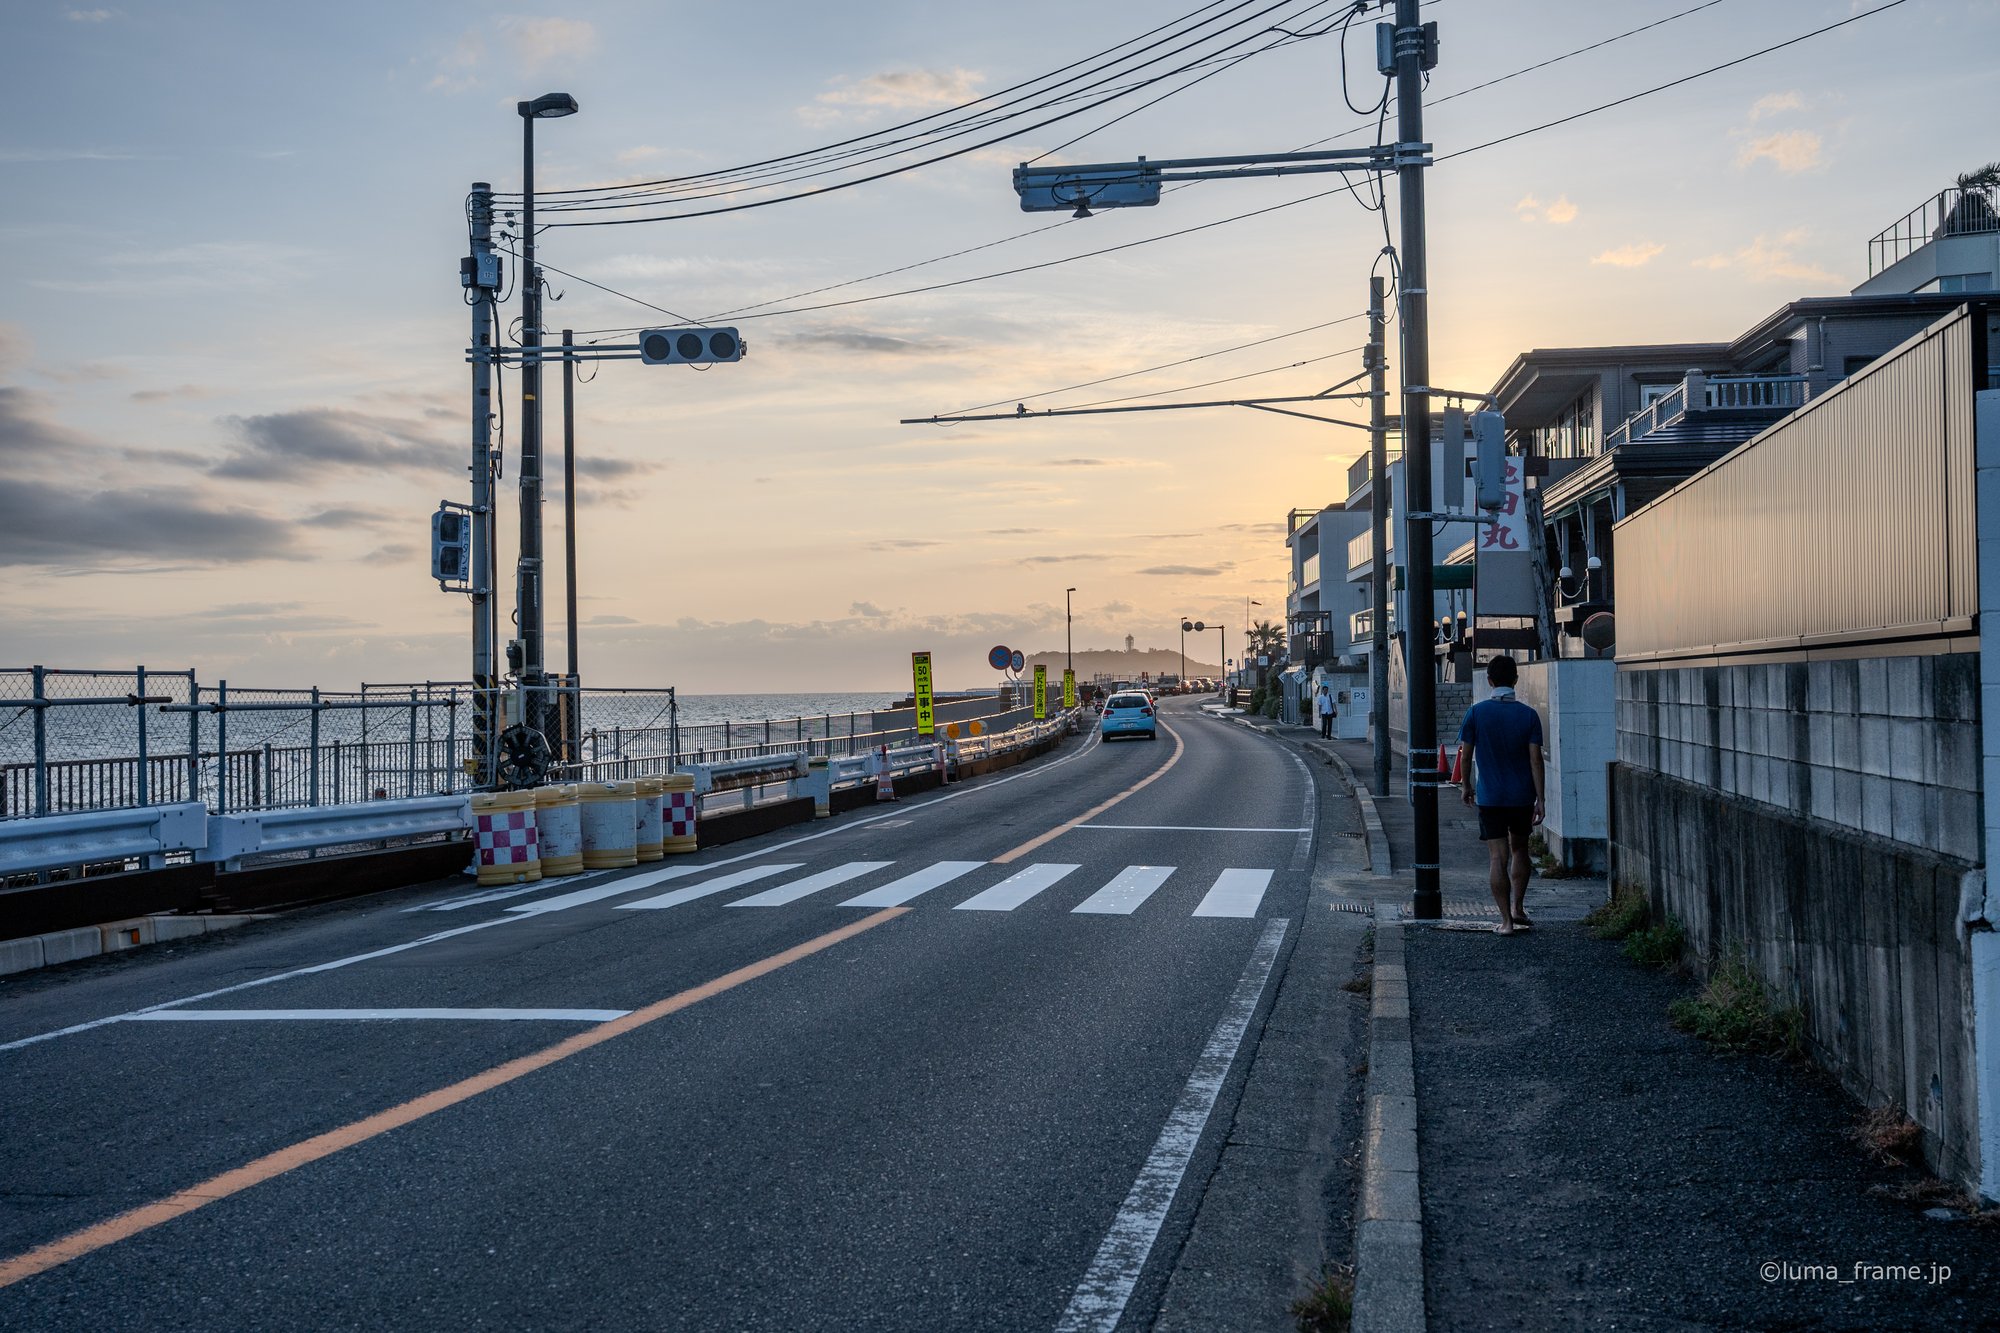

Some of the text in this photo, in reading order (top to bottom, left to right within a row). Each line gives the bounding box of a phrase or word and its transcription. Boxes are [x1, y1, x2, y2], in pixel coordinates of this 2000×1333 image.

[918, 666, 928, 675] 50
[1294, 671, 1305, 681] P2
[1353, 691, 1366, 700] P3
[918, 684, 931, 721] 工事中
